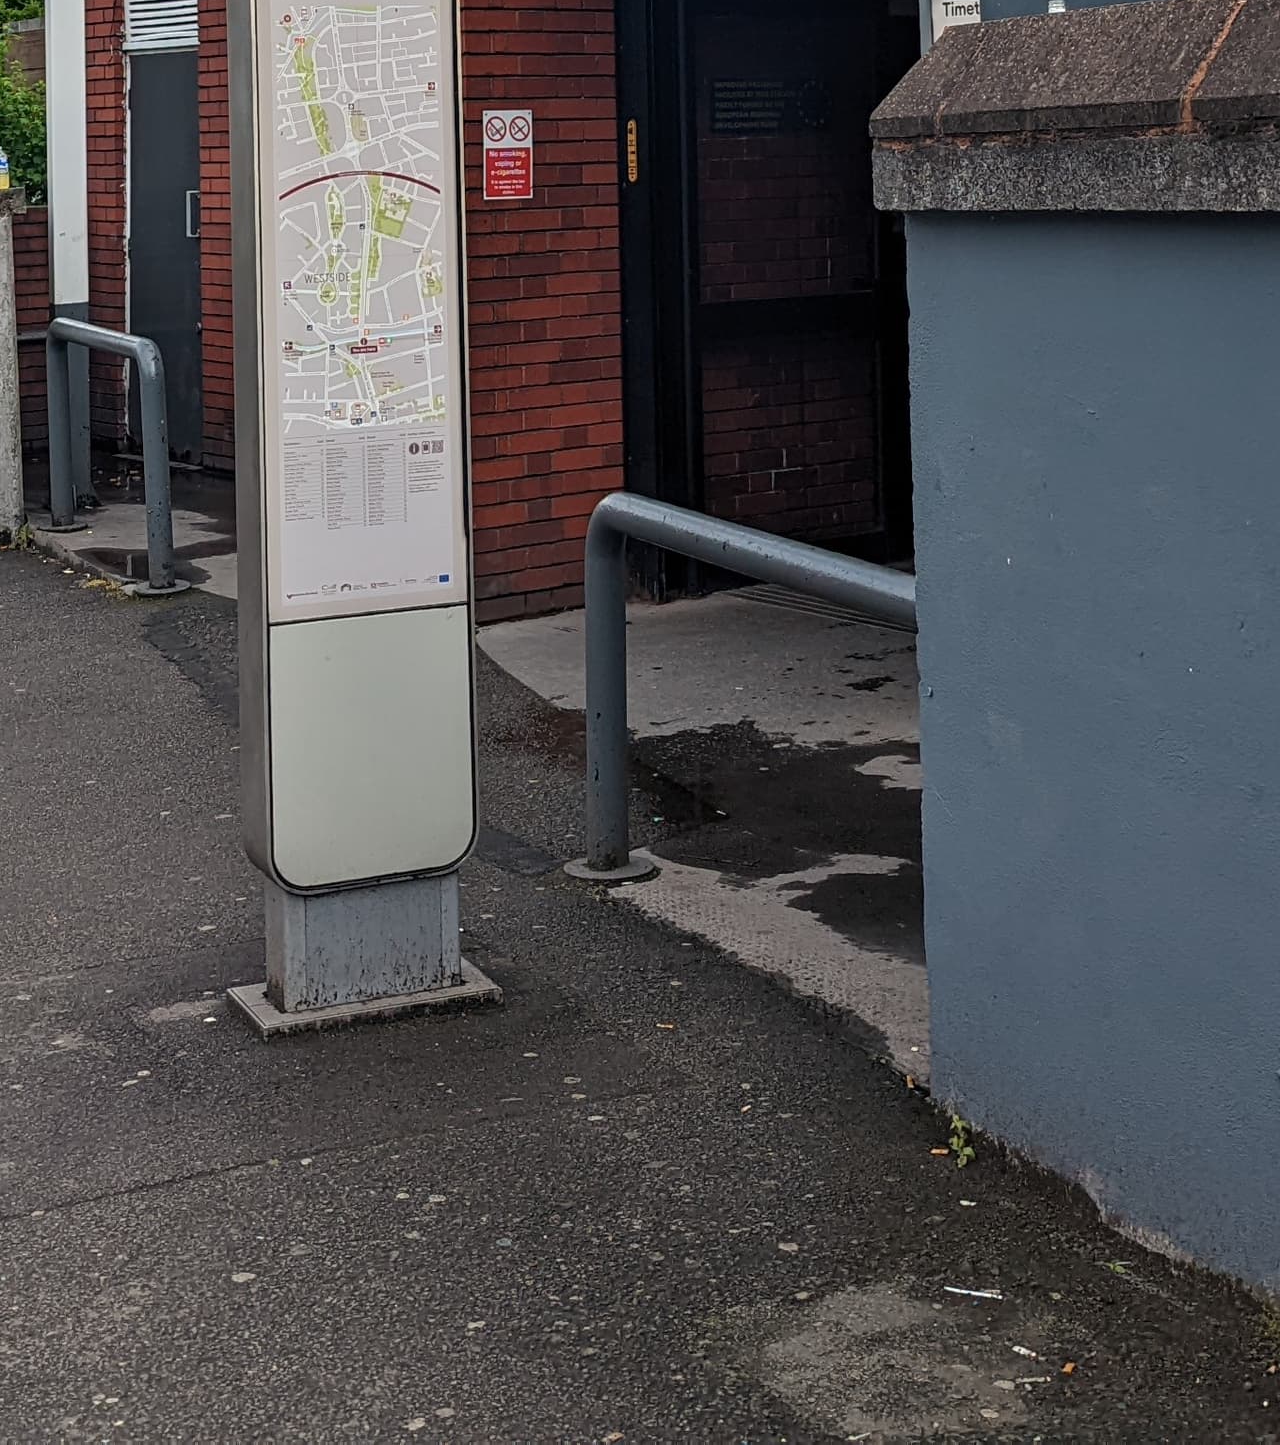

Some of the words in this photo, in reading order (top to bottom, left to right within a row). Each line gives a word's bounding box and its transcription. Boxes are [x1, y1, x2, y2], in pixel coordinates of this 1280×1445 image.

[942, 1, 980, 17] Timet
[489, 150, 498, 158] No
[305, 273, 351, 284] WESTSIDE
